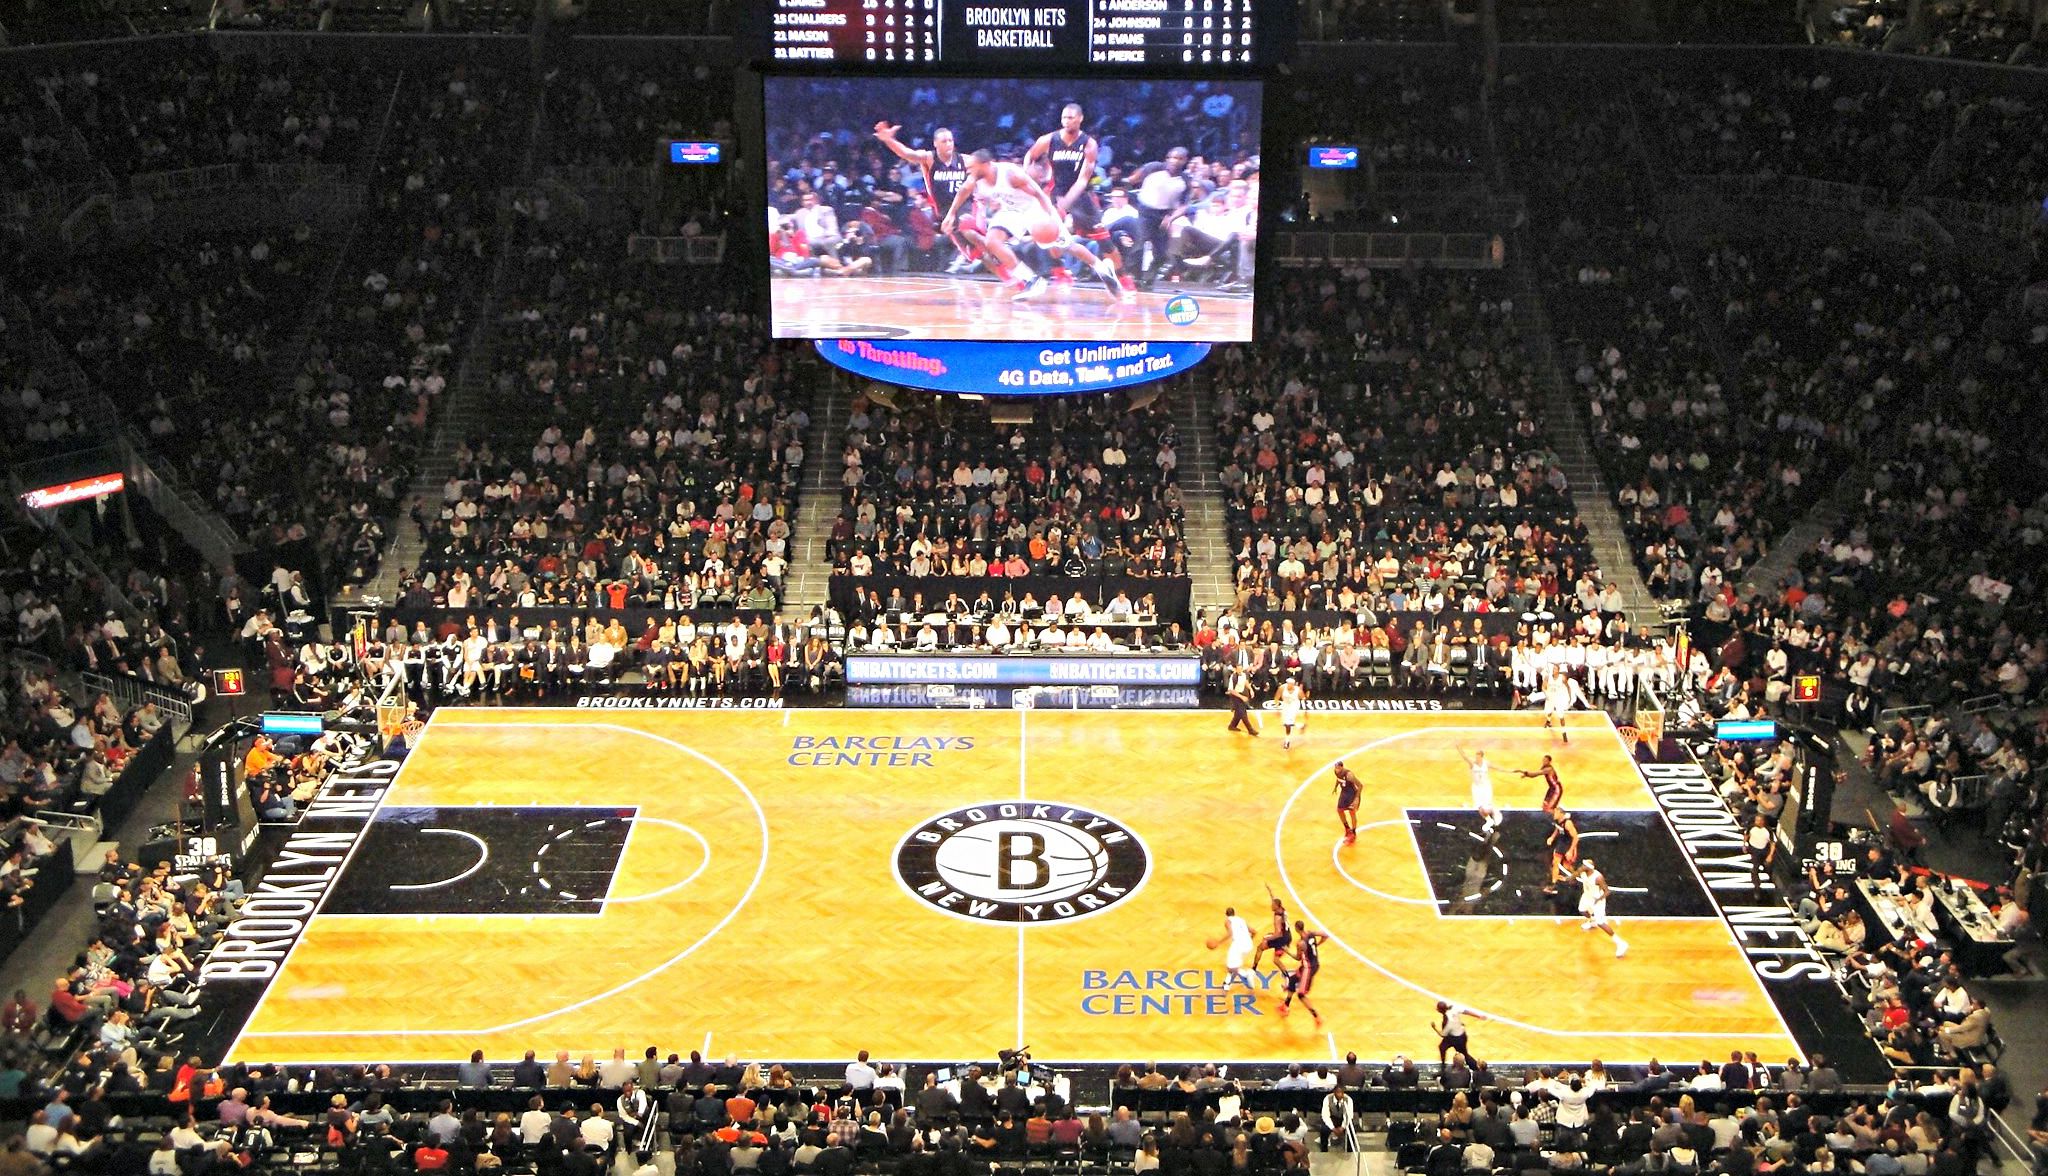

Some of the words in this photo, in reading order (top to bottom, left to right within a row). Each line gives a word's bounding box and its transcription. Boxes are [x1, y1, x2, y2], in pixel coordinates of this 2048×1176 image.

[1109, 0, 1167, 10] ANDERSON
[788, 14, 846, 25] CHALMERS
[966, 7, 1030, 25] BROOKLYN
[1034, 8, 1066, 26] NETS
[1109, 17, 1160, 28] JOHNSON
[788, 31, 828, 42] MASON
[978, 29, 1054, 47] BASKETBALL
[1108, 34, 1144, 45] EVANS
[788, 47, 834, 59] BATTIER
[1108, 50, 1145, 61] PIERCE
[934, 170, 965, 181] MIAMI
[857, 341, 948, 377] Throttling.
[1039, 350, 1071, 366] Get
[1074, 342, 1147, 364] Unlimited
[999, 370, 1024, 386] 4G
[1029, 370, 1073, 386] Data,
[1075, 366, 1113, 382] Talk,
[1116, 360, 1144, 378] and
[1146, 354, 1173, 372] Text.
[577, 696, 784, 709] BROOKLYNNETS.COM
[1262, 699, 1443, 712] @ROOKLYNNETS
[793, 736, 975, 750] BARCLAYS
[788, 752, 935, 767] CENTER
[915, 804, 1130, 843] BROOKLYN
[1640, 763, 1776, 889] BROOKLYN
[998, 831, 1051, 890] B
[201, 832, 359, 979] BROOKLYN
[917, 880, 999, 917] NEW
[1024, 881, 1127, 921] YORK
[1722, 905, 1832, 980] NETS
[1083, 970, 1296, 990] BARCLAY
[1081, 994, 1264, 1016] CENTER
